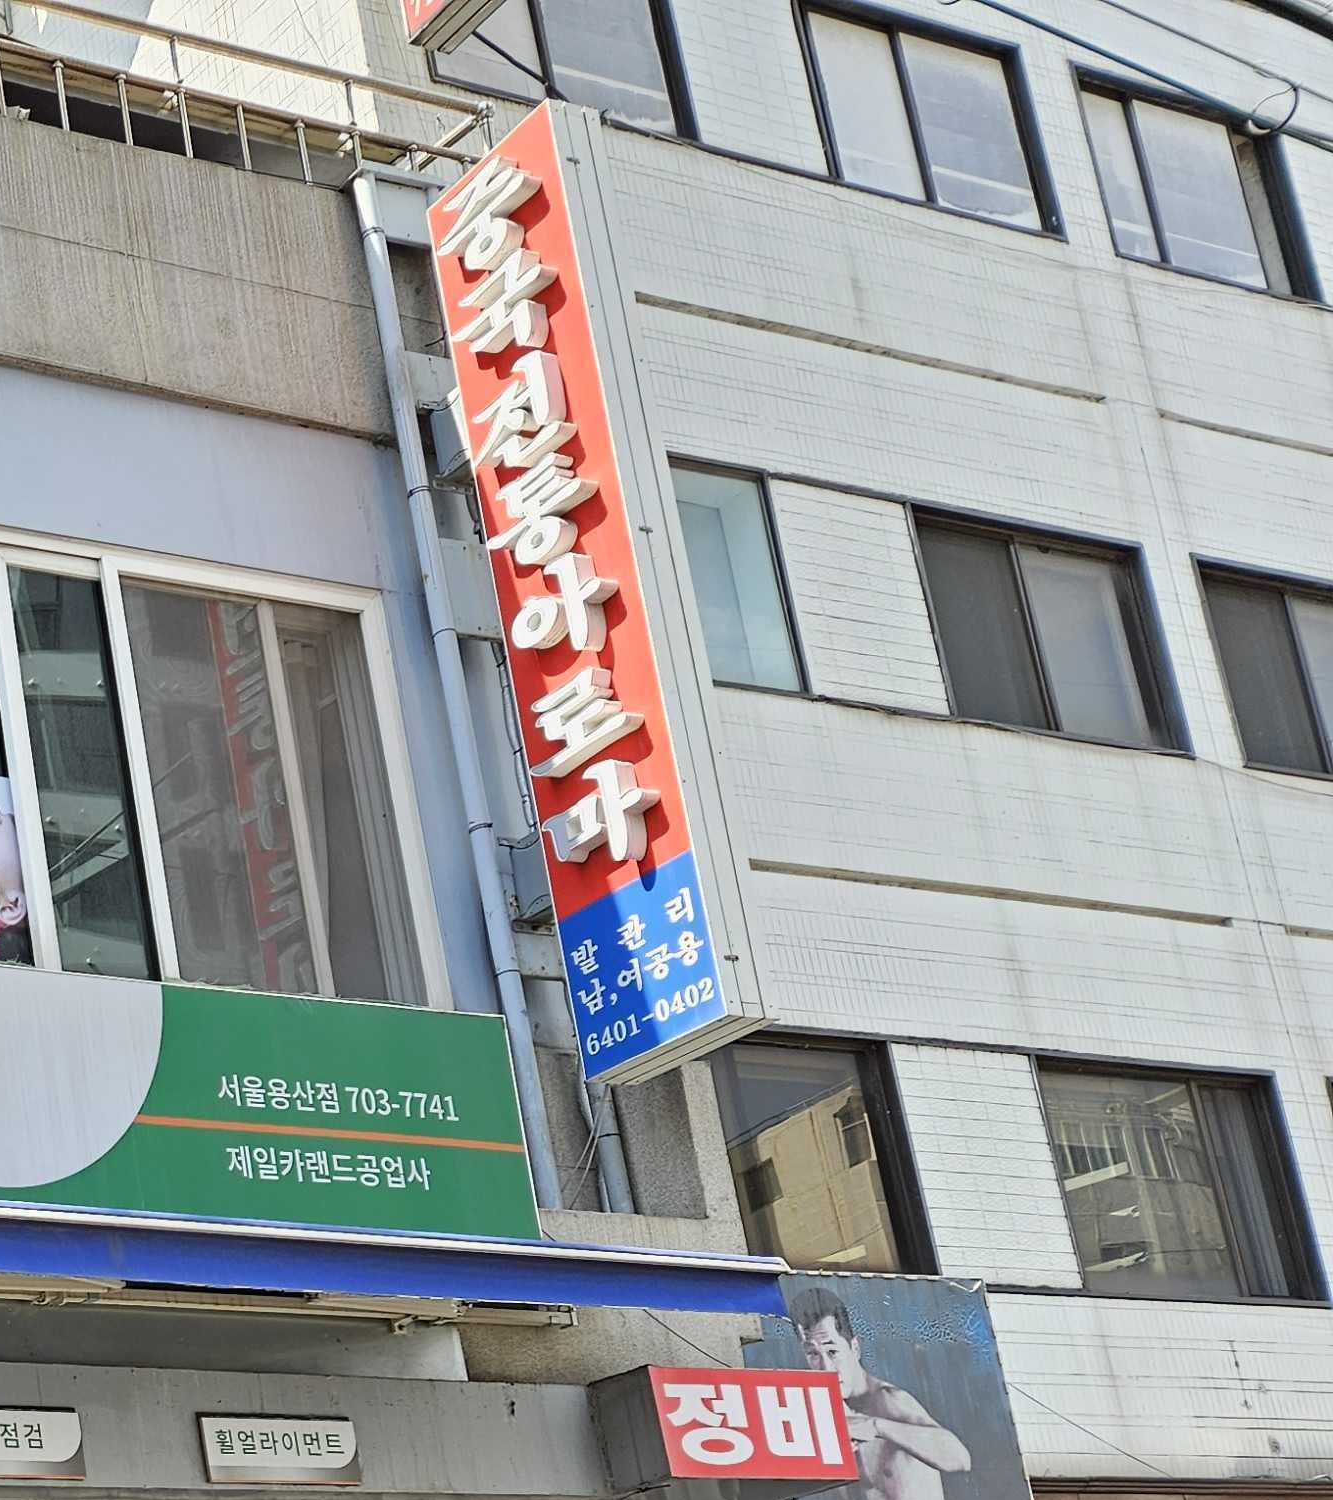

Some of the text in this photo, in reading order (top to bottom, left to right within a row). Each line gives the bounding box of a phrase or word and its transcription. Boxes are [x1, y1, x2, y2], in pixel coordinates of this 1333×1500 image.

[437, 155, 661, 861] 중국전통아로마
[586, 976, 716, 1057] 6401-0402
[217, 1073, 460, 1122] 서울용산점 703-7741
[225, 1145, 431, 1191] 제일카랜드공업사
[214, 1428, 346, 1457] 휠얼라이먼트
[662, 1382, 845, 1466] 정비
